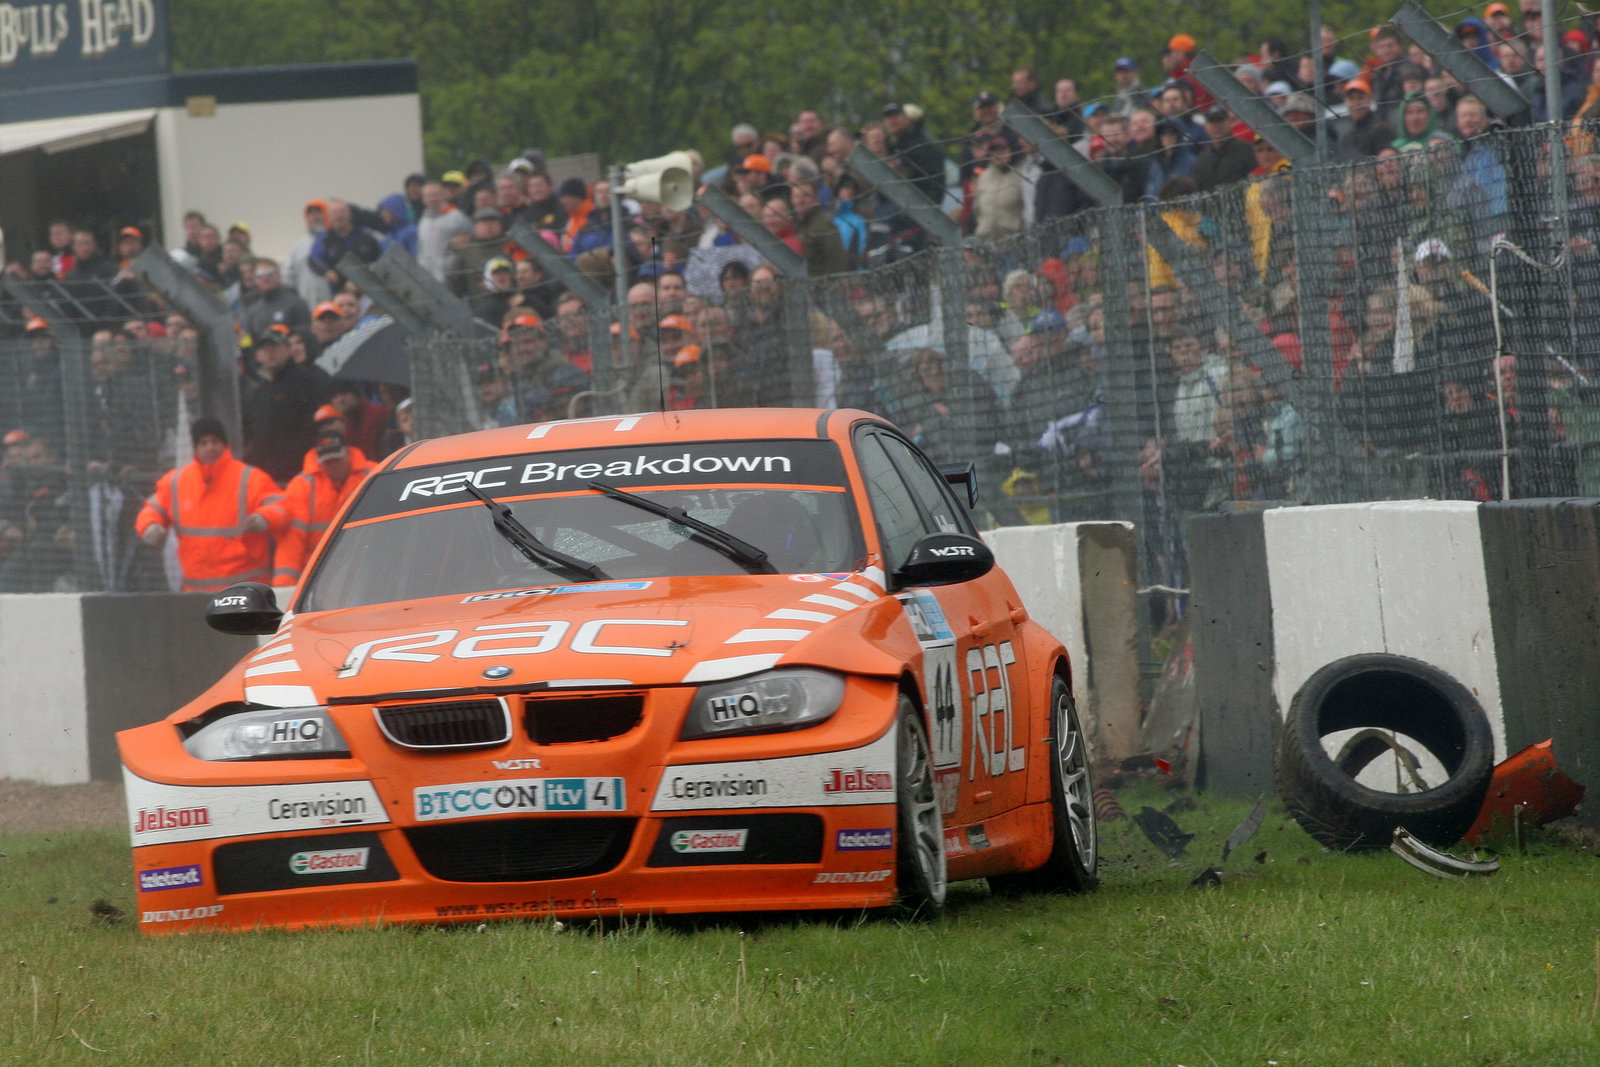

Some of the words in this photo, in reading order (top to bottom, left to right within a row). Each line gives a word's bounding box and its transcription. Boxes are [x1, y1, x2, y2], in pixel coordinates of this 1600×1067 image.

[520, 453, 792, 484] Breakdown
[929, 546, 976, 556] WSR
[214, 596, 247, 607] WSR
[711, 694, 760, 722] HiQ
[272, 720, 322, 741] HiQ
[492, 758, 541, 770] WSR
[548, 783, 583, 807] itv
[672, 773, 767, 800] Ceravision
[268, 792, 367, 821] Ceravision
[134, 804, 212, 833] Jelson
[690, 832, 742, 850] Castrol
[309, 852, 366, 870] Castrol
[813, 870, 892, 884] DUNLOP
[141, 905, 225, 923] DUNLOP
